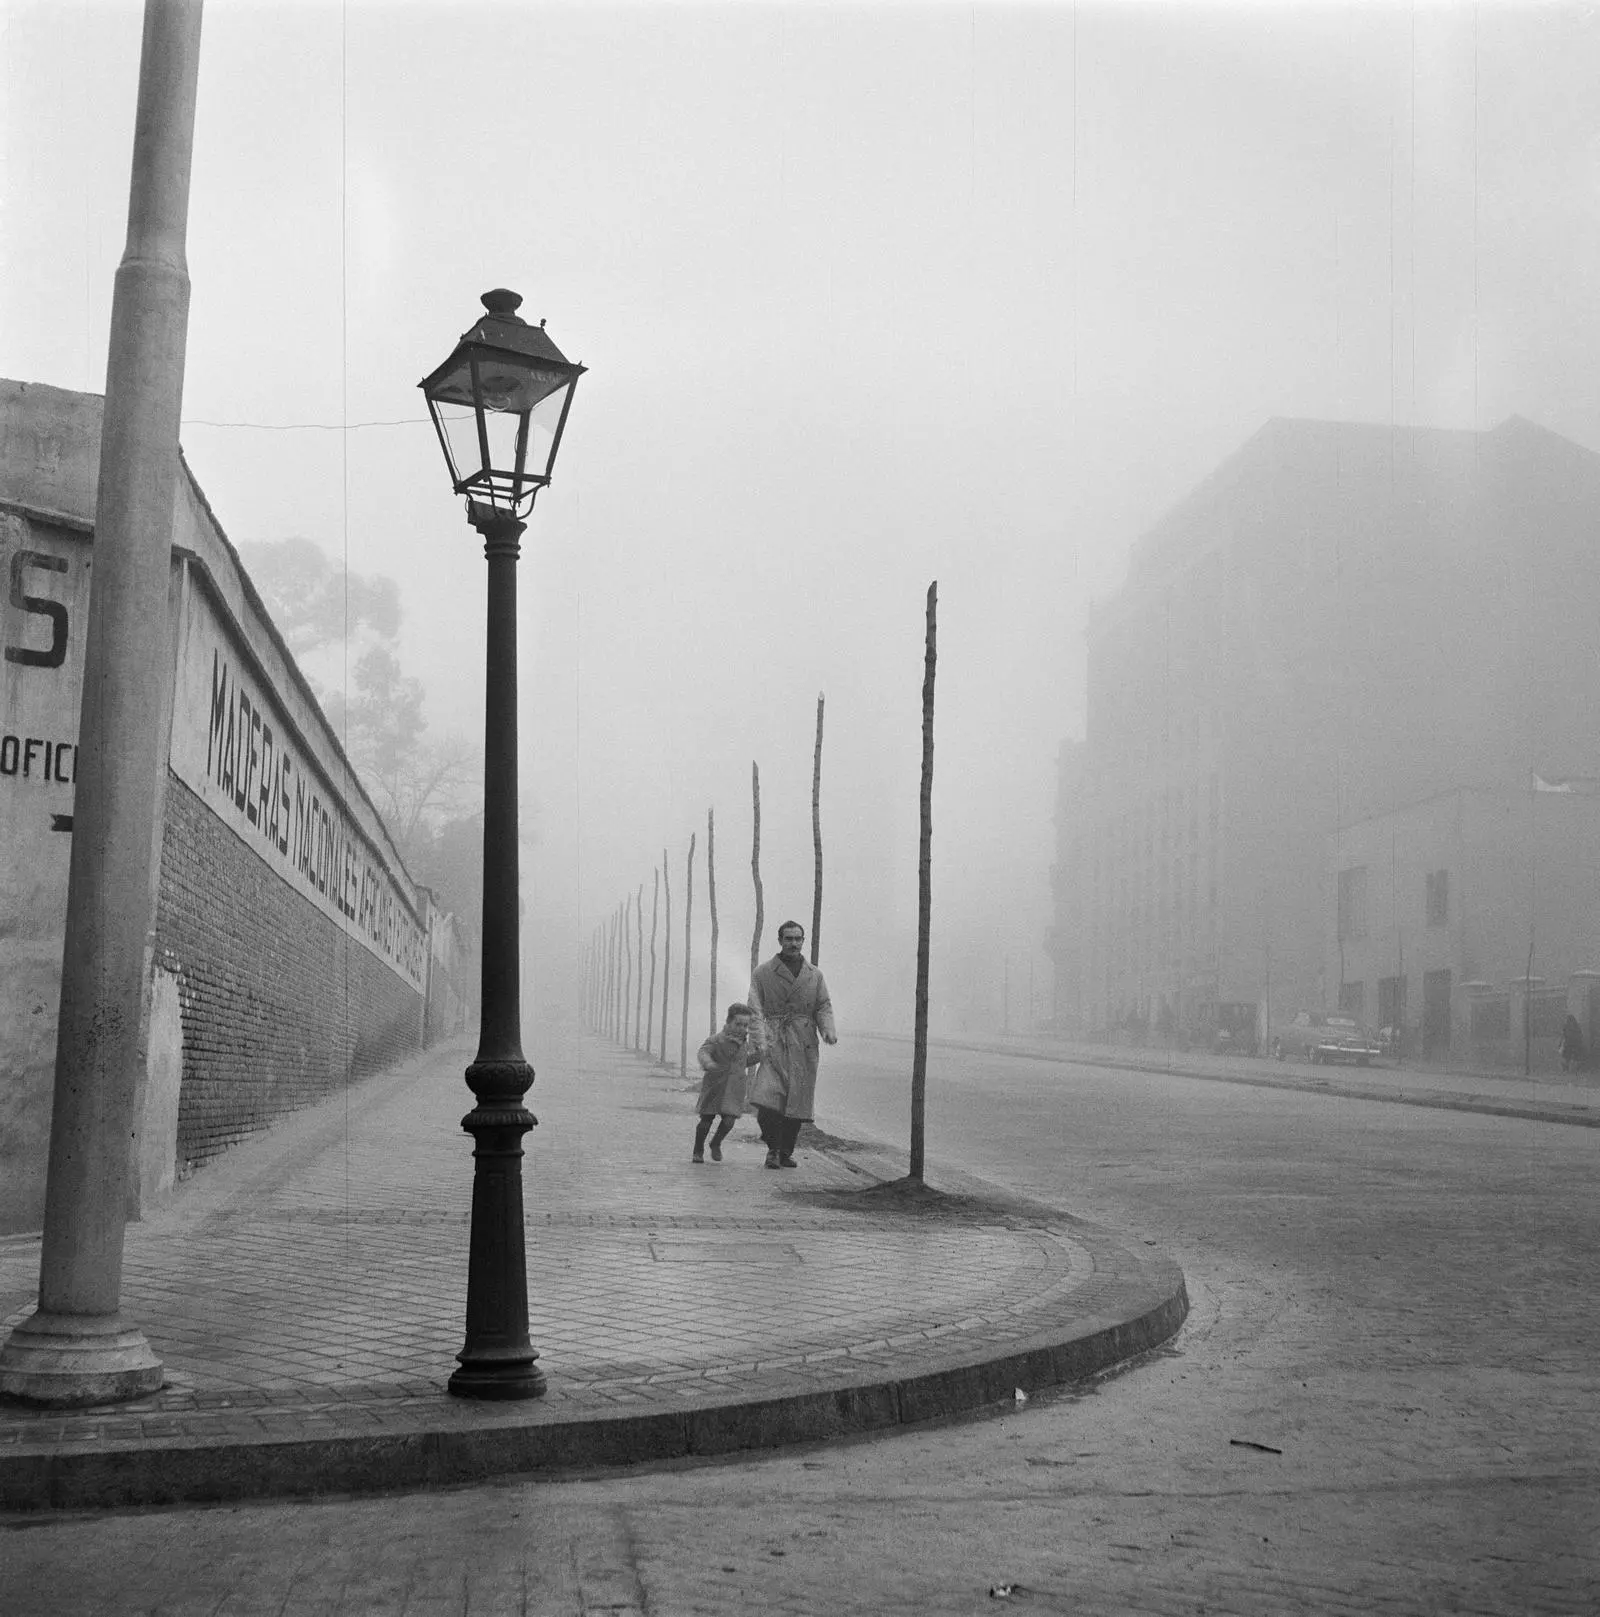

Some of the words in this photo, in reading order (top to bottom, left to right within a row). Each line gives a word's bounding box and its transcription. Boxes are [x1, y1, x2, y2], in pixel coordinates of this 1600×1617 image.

[4, 548, 69, 669] S
[206, 648, 291, 857] MADERAS
[292, 769, 358, 922] NACIONALES
